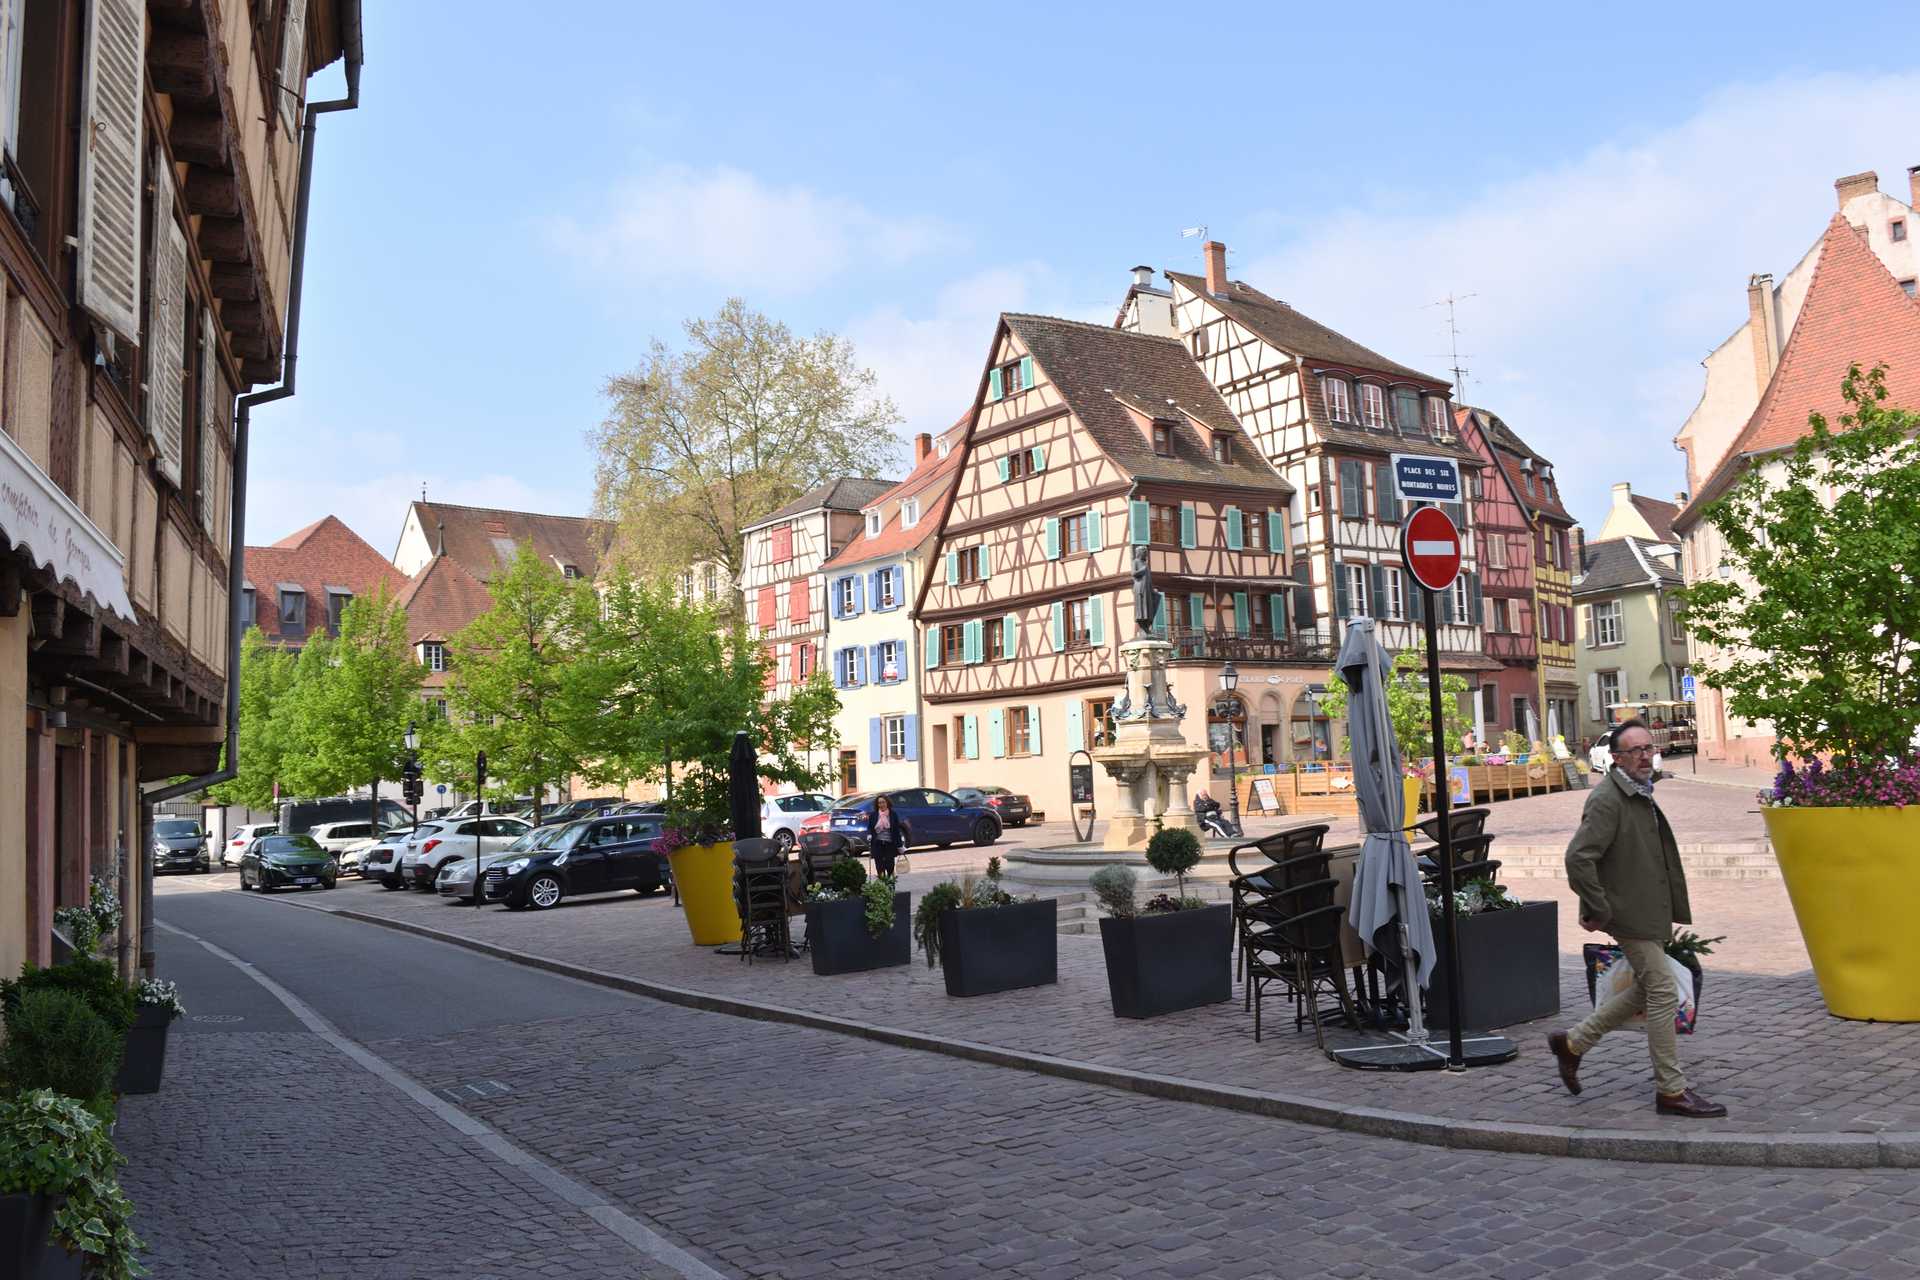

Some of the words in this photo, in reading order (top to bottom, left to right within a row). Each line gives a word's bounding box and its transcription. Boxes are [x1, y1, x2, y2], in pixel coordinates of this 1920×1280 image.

[1403, 466, 1421, 475] PLACE
[1425, 468, 1436, 476] DES
[1440, 469, 1449, 477] SIX
[1401, 480, 1433, 490] MONTAGNES
